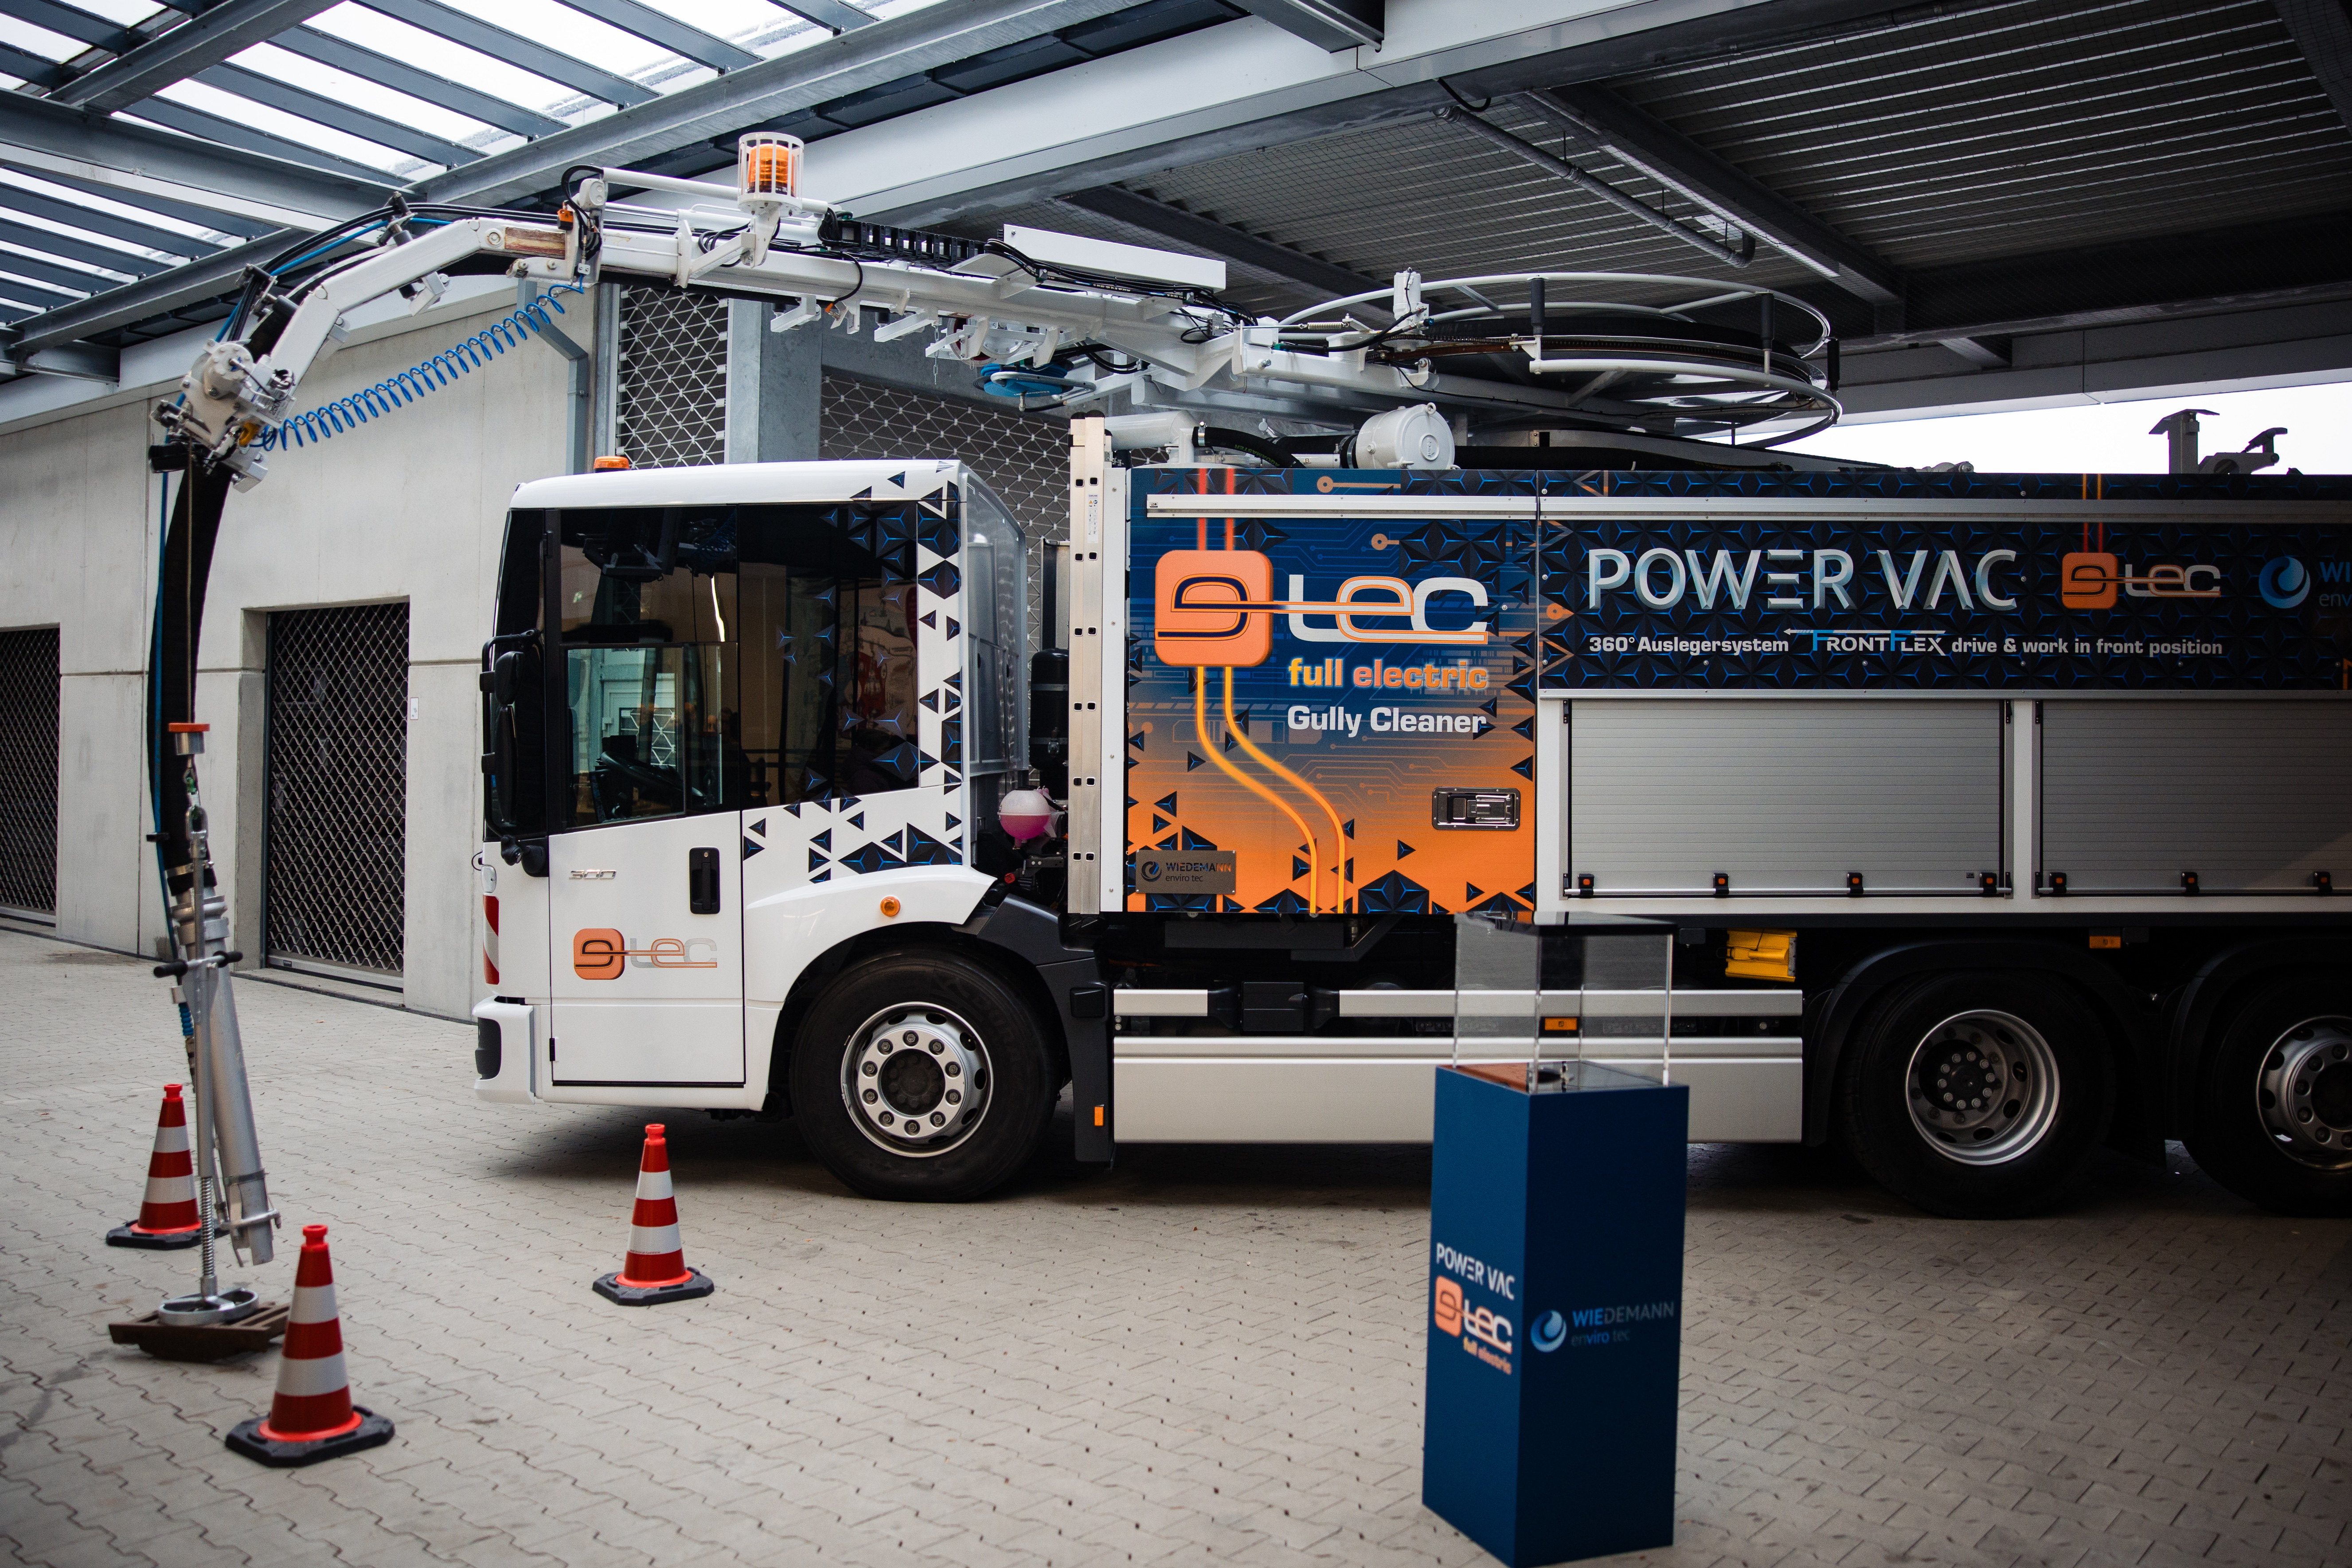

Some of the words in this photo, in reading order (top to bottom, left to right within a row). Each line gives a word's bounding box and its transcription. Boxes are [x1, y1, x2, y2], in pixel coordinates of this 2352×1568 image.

[1234, 444, 1280, 467] AQUAMASTER
[1589, 547, 1856, 610] POWER
[1877, 549, 2018, 611] VAC
[1589, 637, 1635, 653] 360°
[1637, 637, 1789, 656] Auslegersystem
[1951, 637, 1997, 654] drive
[2003, 638, 2017, 653] &
[2023, 637, 2068, 654] work
[2074, 638, 2090, 654] in
[2097, 638, 2143, 654] front
[2149, 639, 2222, 657] position
[1288, 658, 1343, 687] full
[1353, 660, 1488, 688] electric
[1287, 706, 1361, 738] Gully
[1370, 706, 1487, 734] Cleaner
[1165, 862, 1231, 872] WIEDEMANN
[1436, 1242, 1484, 1286] POWER
[1487, 1265, 1516, 1301] VAC
[1572, 1301, 1675, 1328] WIEDEMANN
[1571, 1329, 1610, 1347] enviro
[1612, 1329, 1631, 1342] tec
